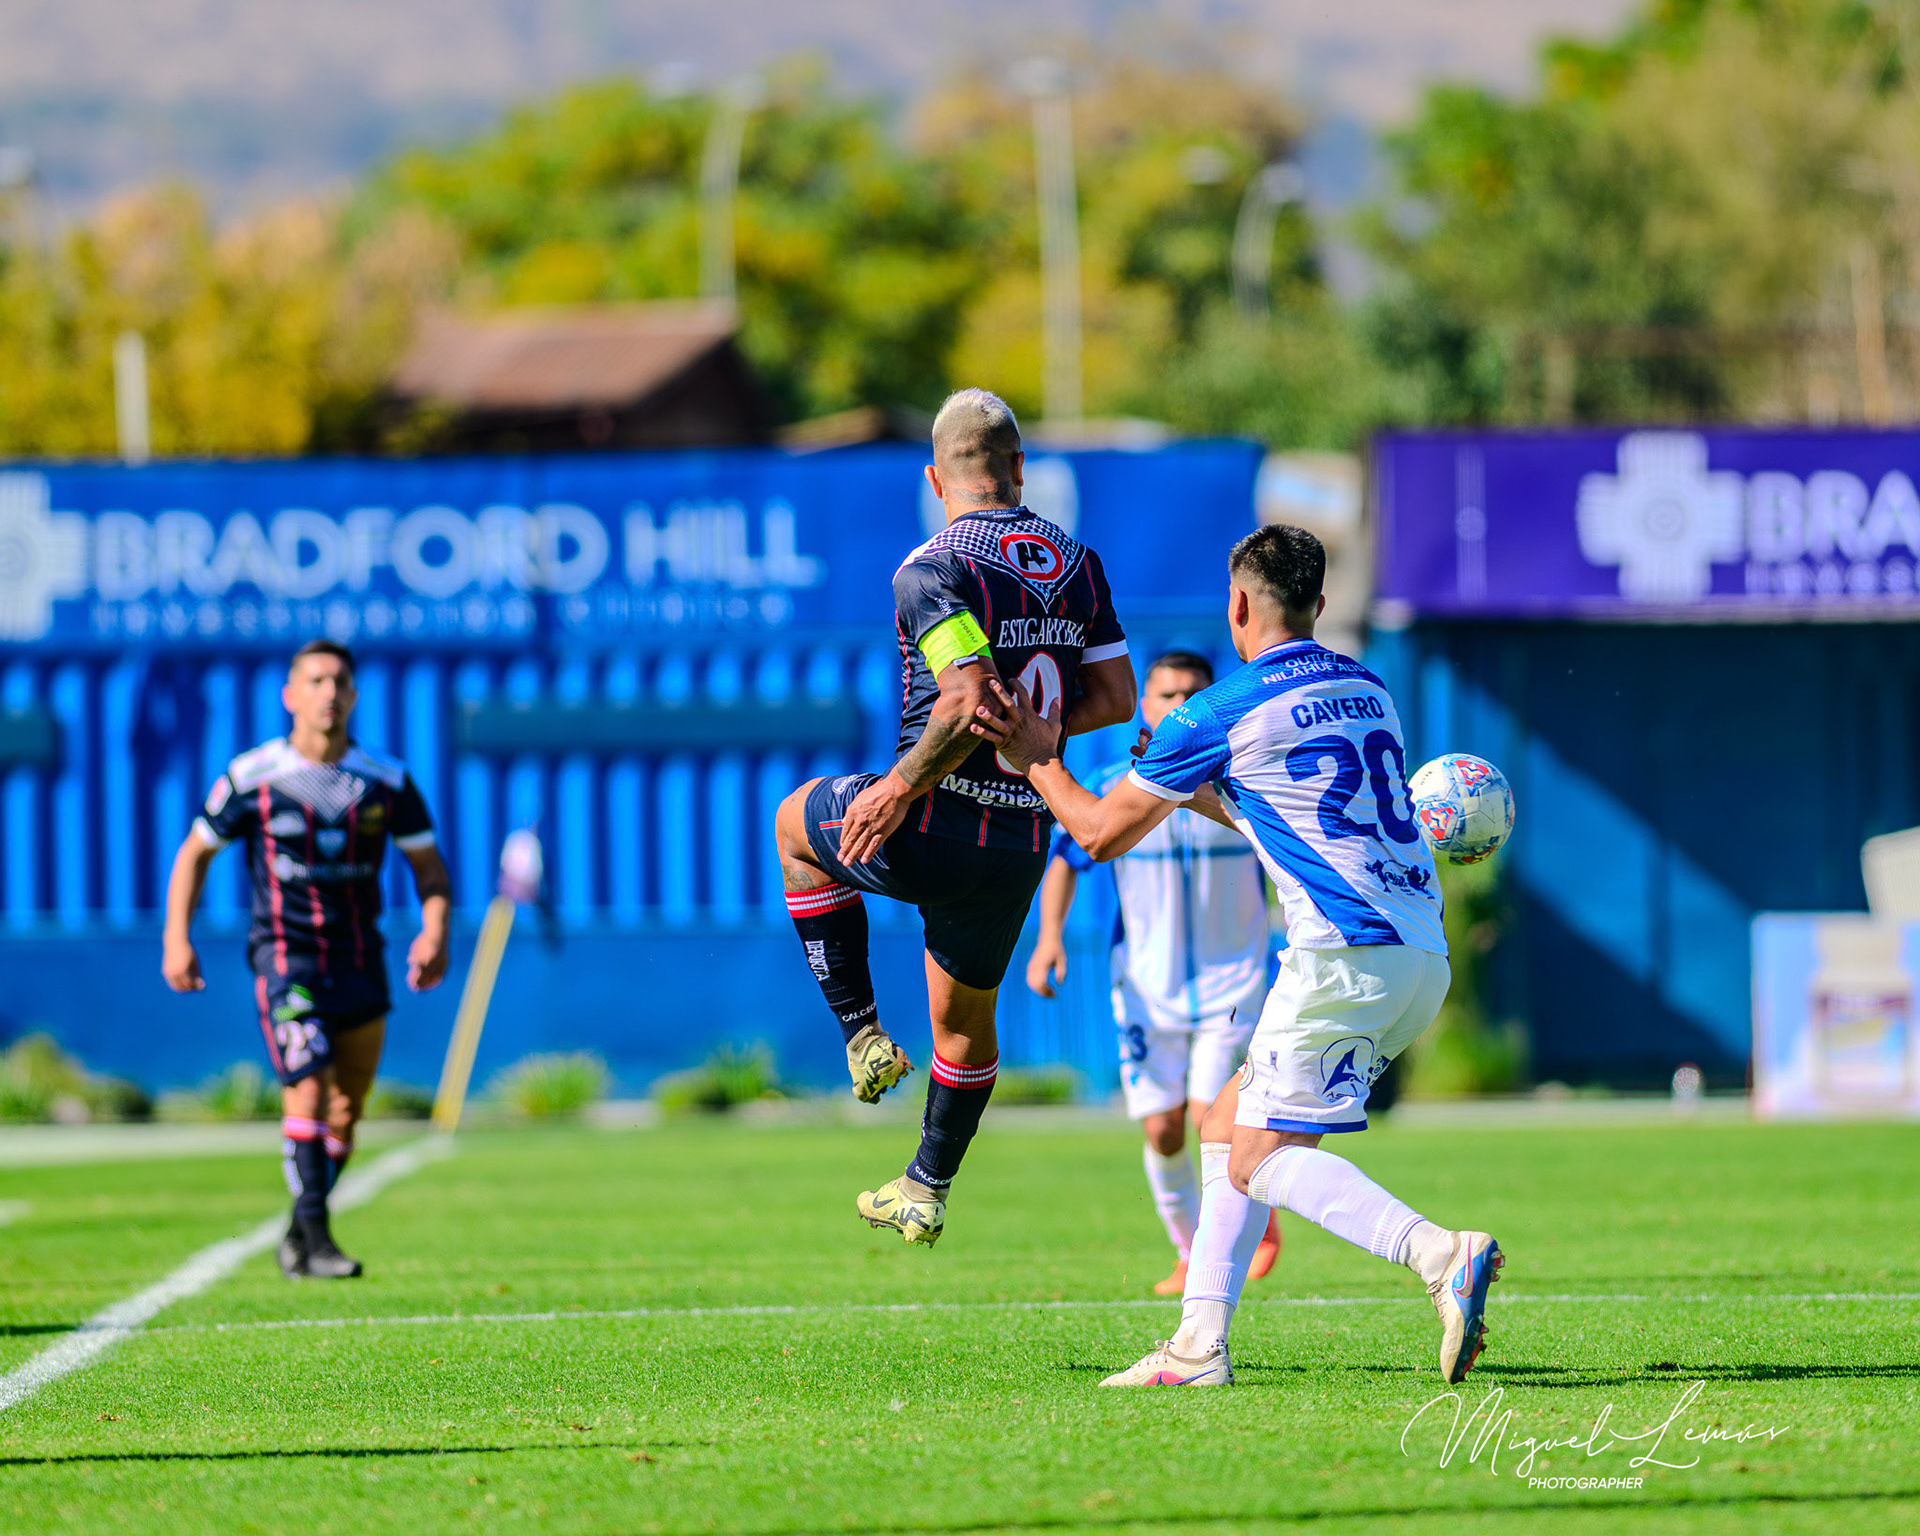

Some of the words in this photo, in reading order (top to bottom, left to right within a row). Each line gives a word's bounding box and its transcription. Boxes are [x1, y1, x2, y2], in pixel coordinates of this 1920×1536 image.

[95, 503, 611, 601] BRADFORD
[622, 500, 828, 589] HILL
[1261, 662, 1334, 685] NILAHUE
[1338, 663, 1366, 673] ALTO
[1284, 653, 1337, 668] OUTLET
[1175, 714, 1198, 729] ALTO
[1290, 695, 1385, 729] CAVERO
[1284, 728, 1420, 845] 20
